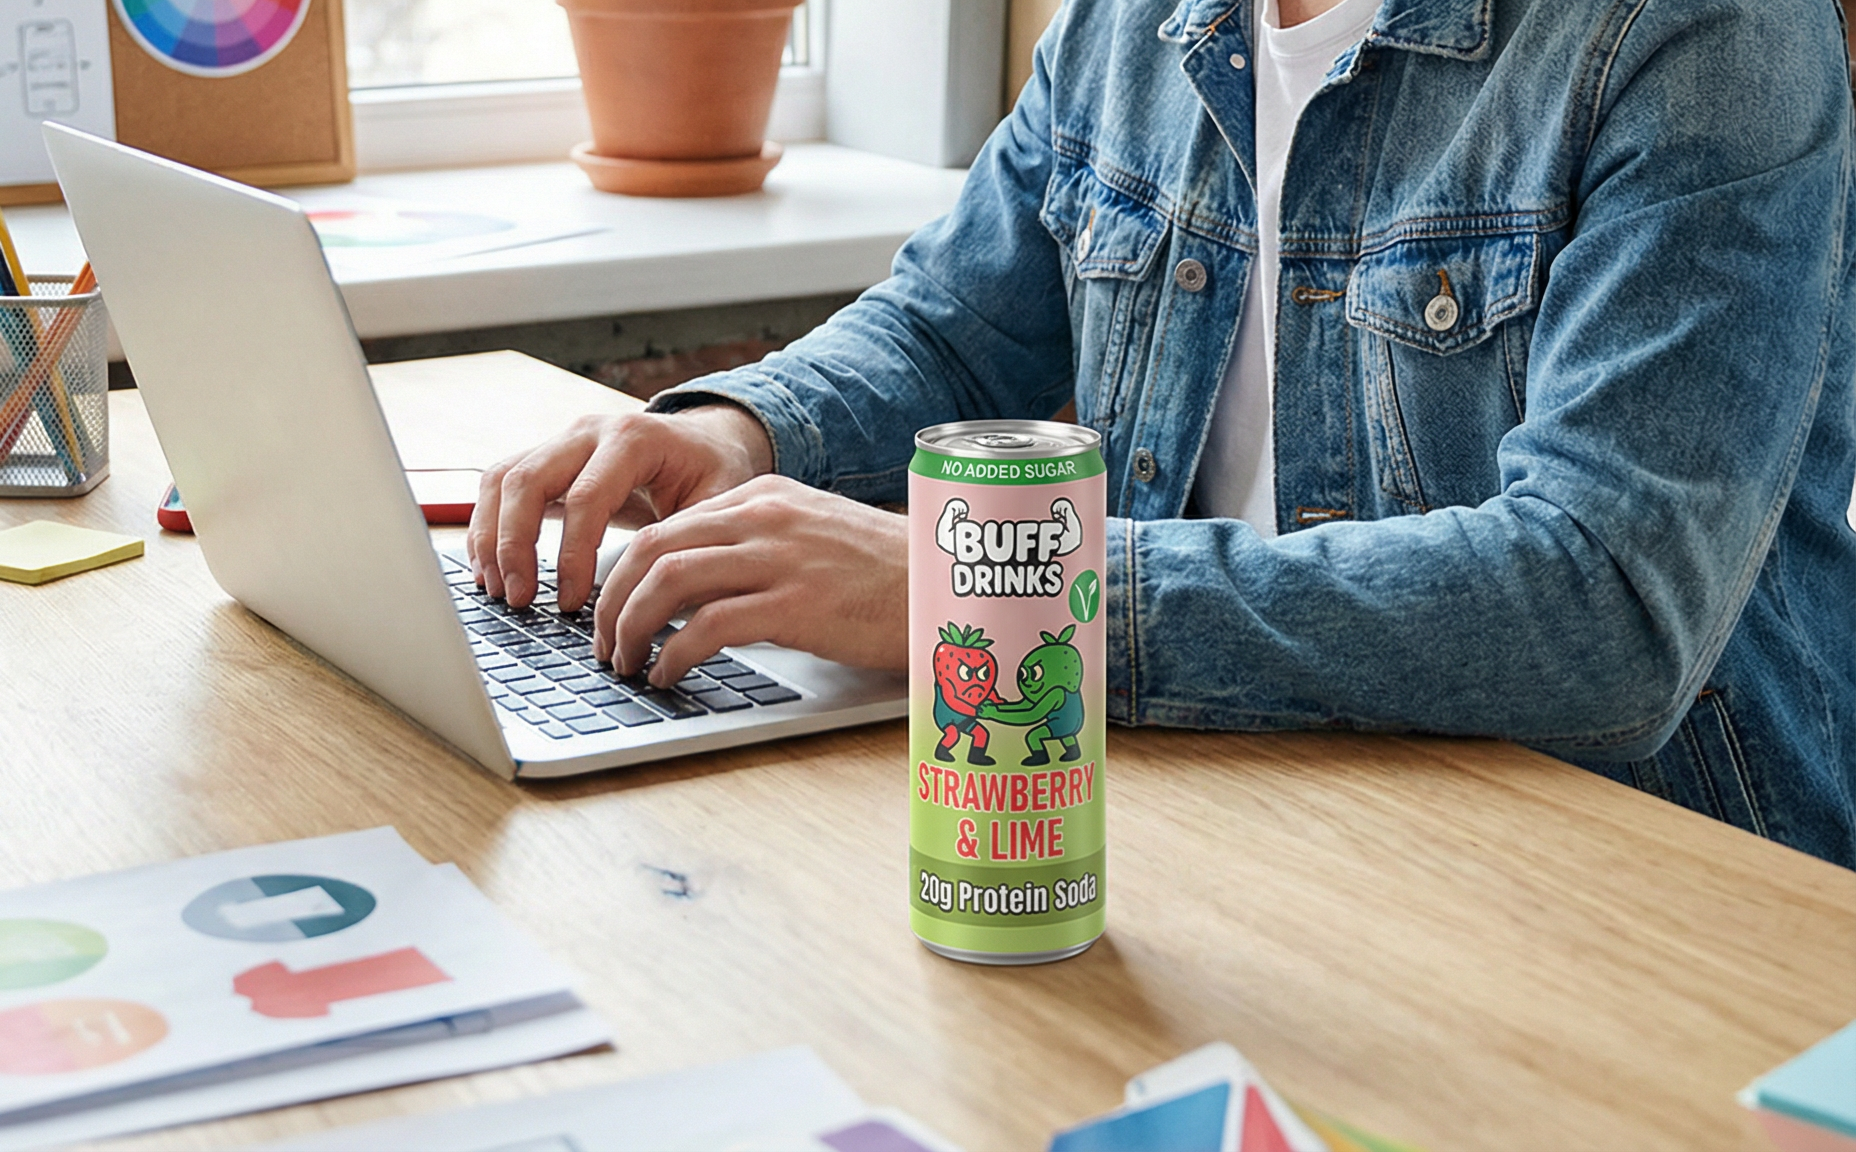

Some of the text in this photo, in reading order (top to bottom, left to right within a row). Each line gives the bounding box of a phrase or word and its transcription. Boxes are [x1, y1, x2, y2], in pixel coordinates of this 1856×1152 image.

[941, 460, 1077, 479] NO ADDED SUGAR
[953, 520, 1065, 563] BUFF
[951, 562, 1064, 598] DRINKS
[918, 761, 1095, 813] STRAWBERRY
[956, 817, 1064, 862] & LIME
[920, 871, 1096, 916] 20g Protein Soda
